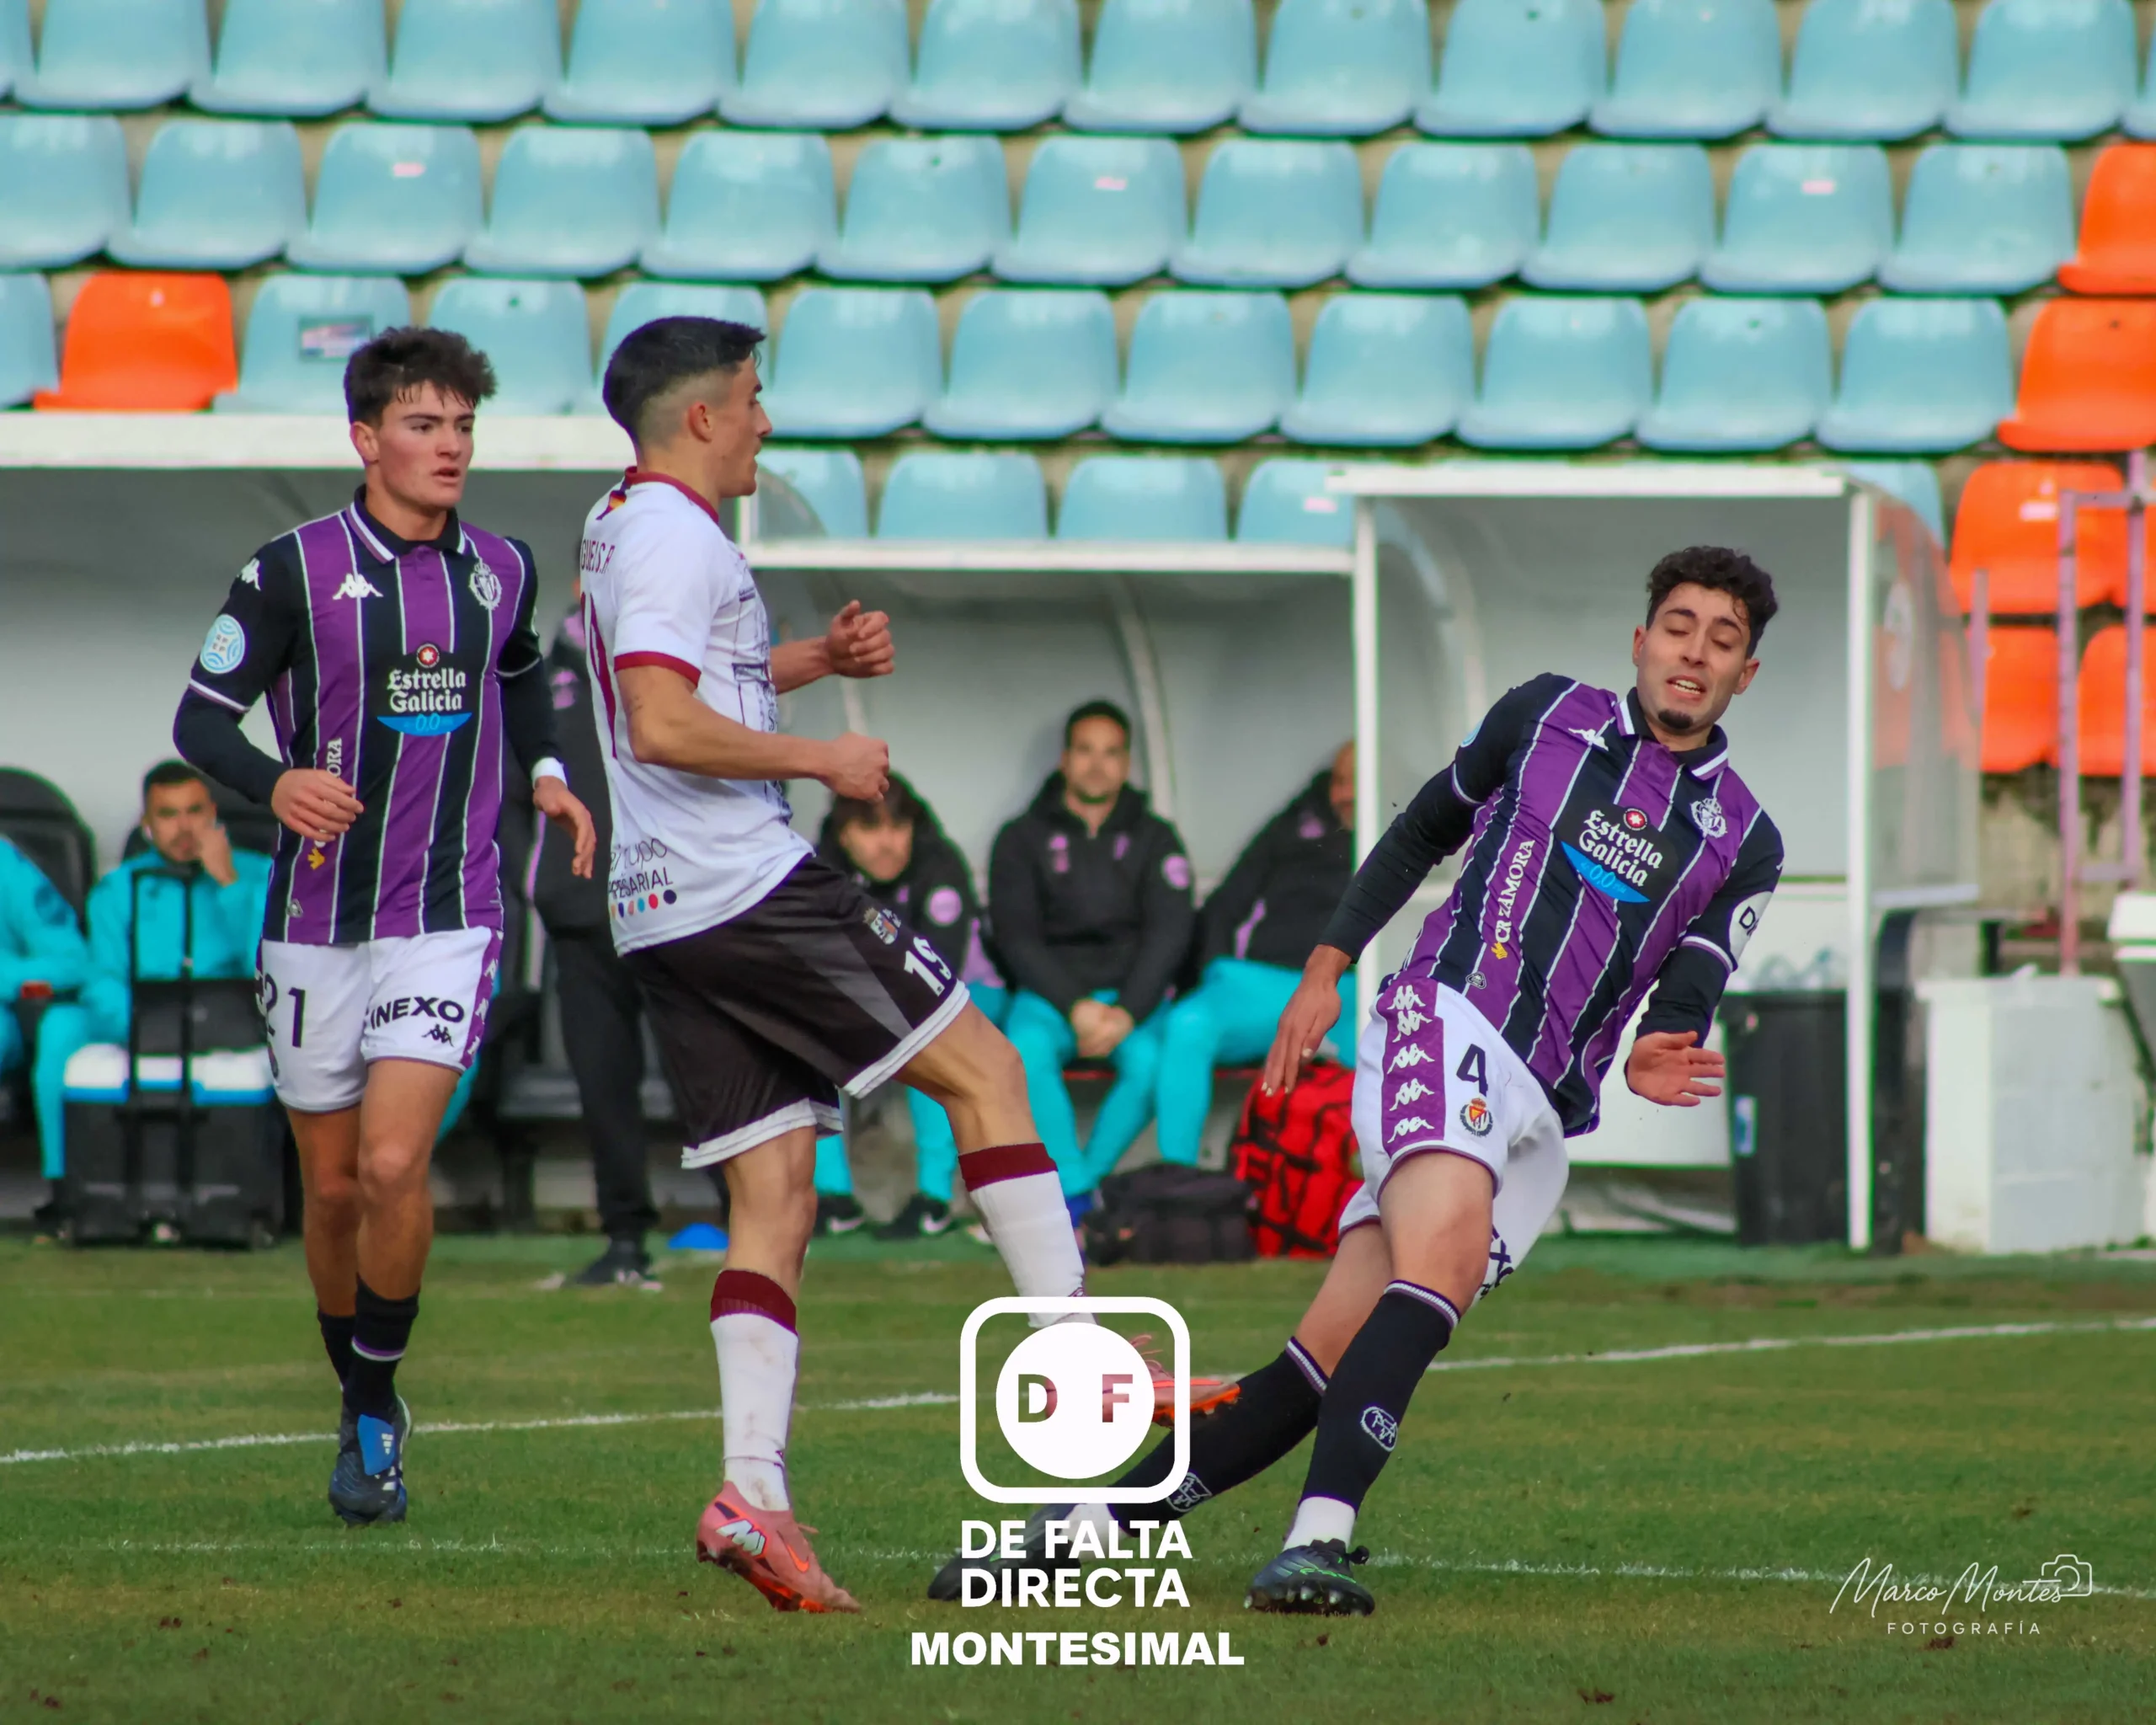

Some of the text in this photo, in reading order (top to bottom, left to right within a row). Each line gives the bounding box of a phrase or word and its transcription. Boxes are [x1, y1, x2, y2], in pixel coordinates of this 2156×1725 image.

[387, 668, 467, 690] Estrella
[390, 690, 462, 713] Galicia
[327, 738, 342, 777] ORA
[1579, 829, 1648, 887] Galicia
[1583, 809, 1663, 868] Estrella
[1495, 840, 1535, 943] CR ZAMORA
[904, 937, 952, 996] 19
[366, 996, 465, 1030] INEXO
[1456, 1044, 1488, 1097] 4
